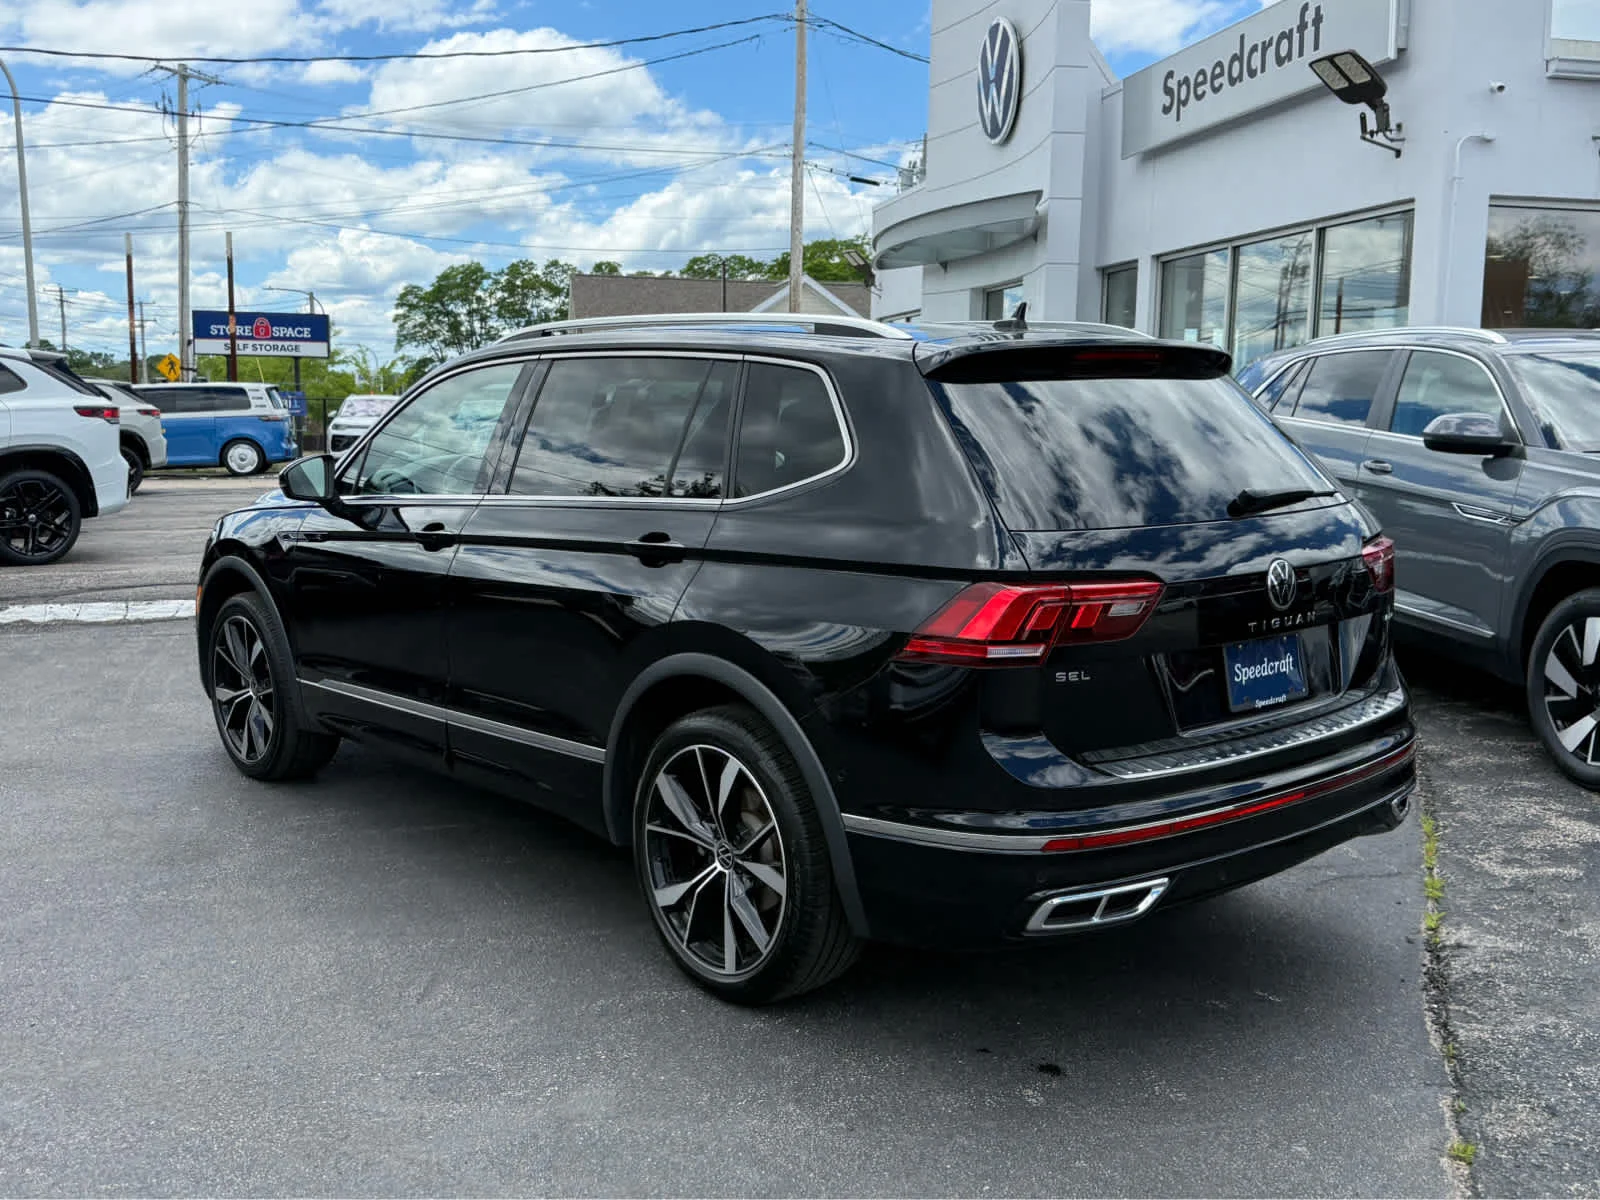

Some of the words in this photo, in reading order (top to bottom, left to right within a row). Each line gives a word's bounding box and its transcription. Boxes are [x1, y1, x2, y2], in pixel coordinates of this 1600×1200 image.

[1162, 2, 1323, 122] Speedcraft
[272, 327, 311, 338] SPACE
[224, 343, 248, 351] SLF
[251, 344, 301, 353] STORAGE
[1248, 611, 1316, 633] TIGUAN
[1234, 652, 1294, 686] Speedcraft
[1055, 671, 1091, 682] SEL
[1255, 694, 1287, 708] Speedcraft
